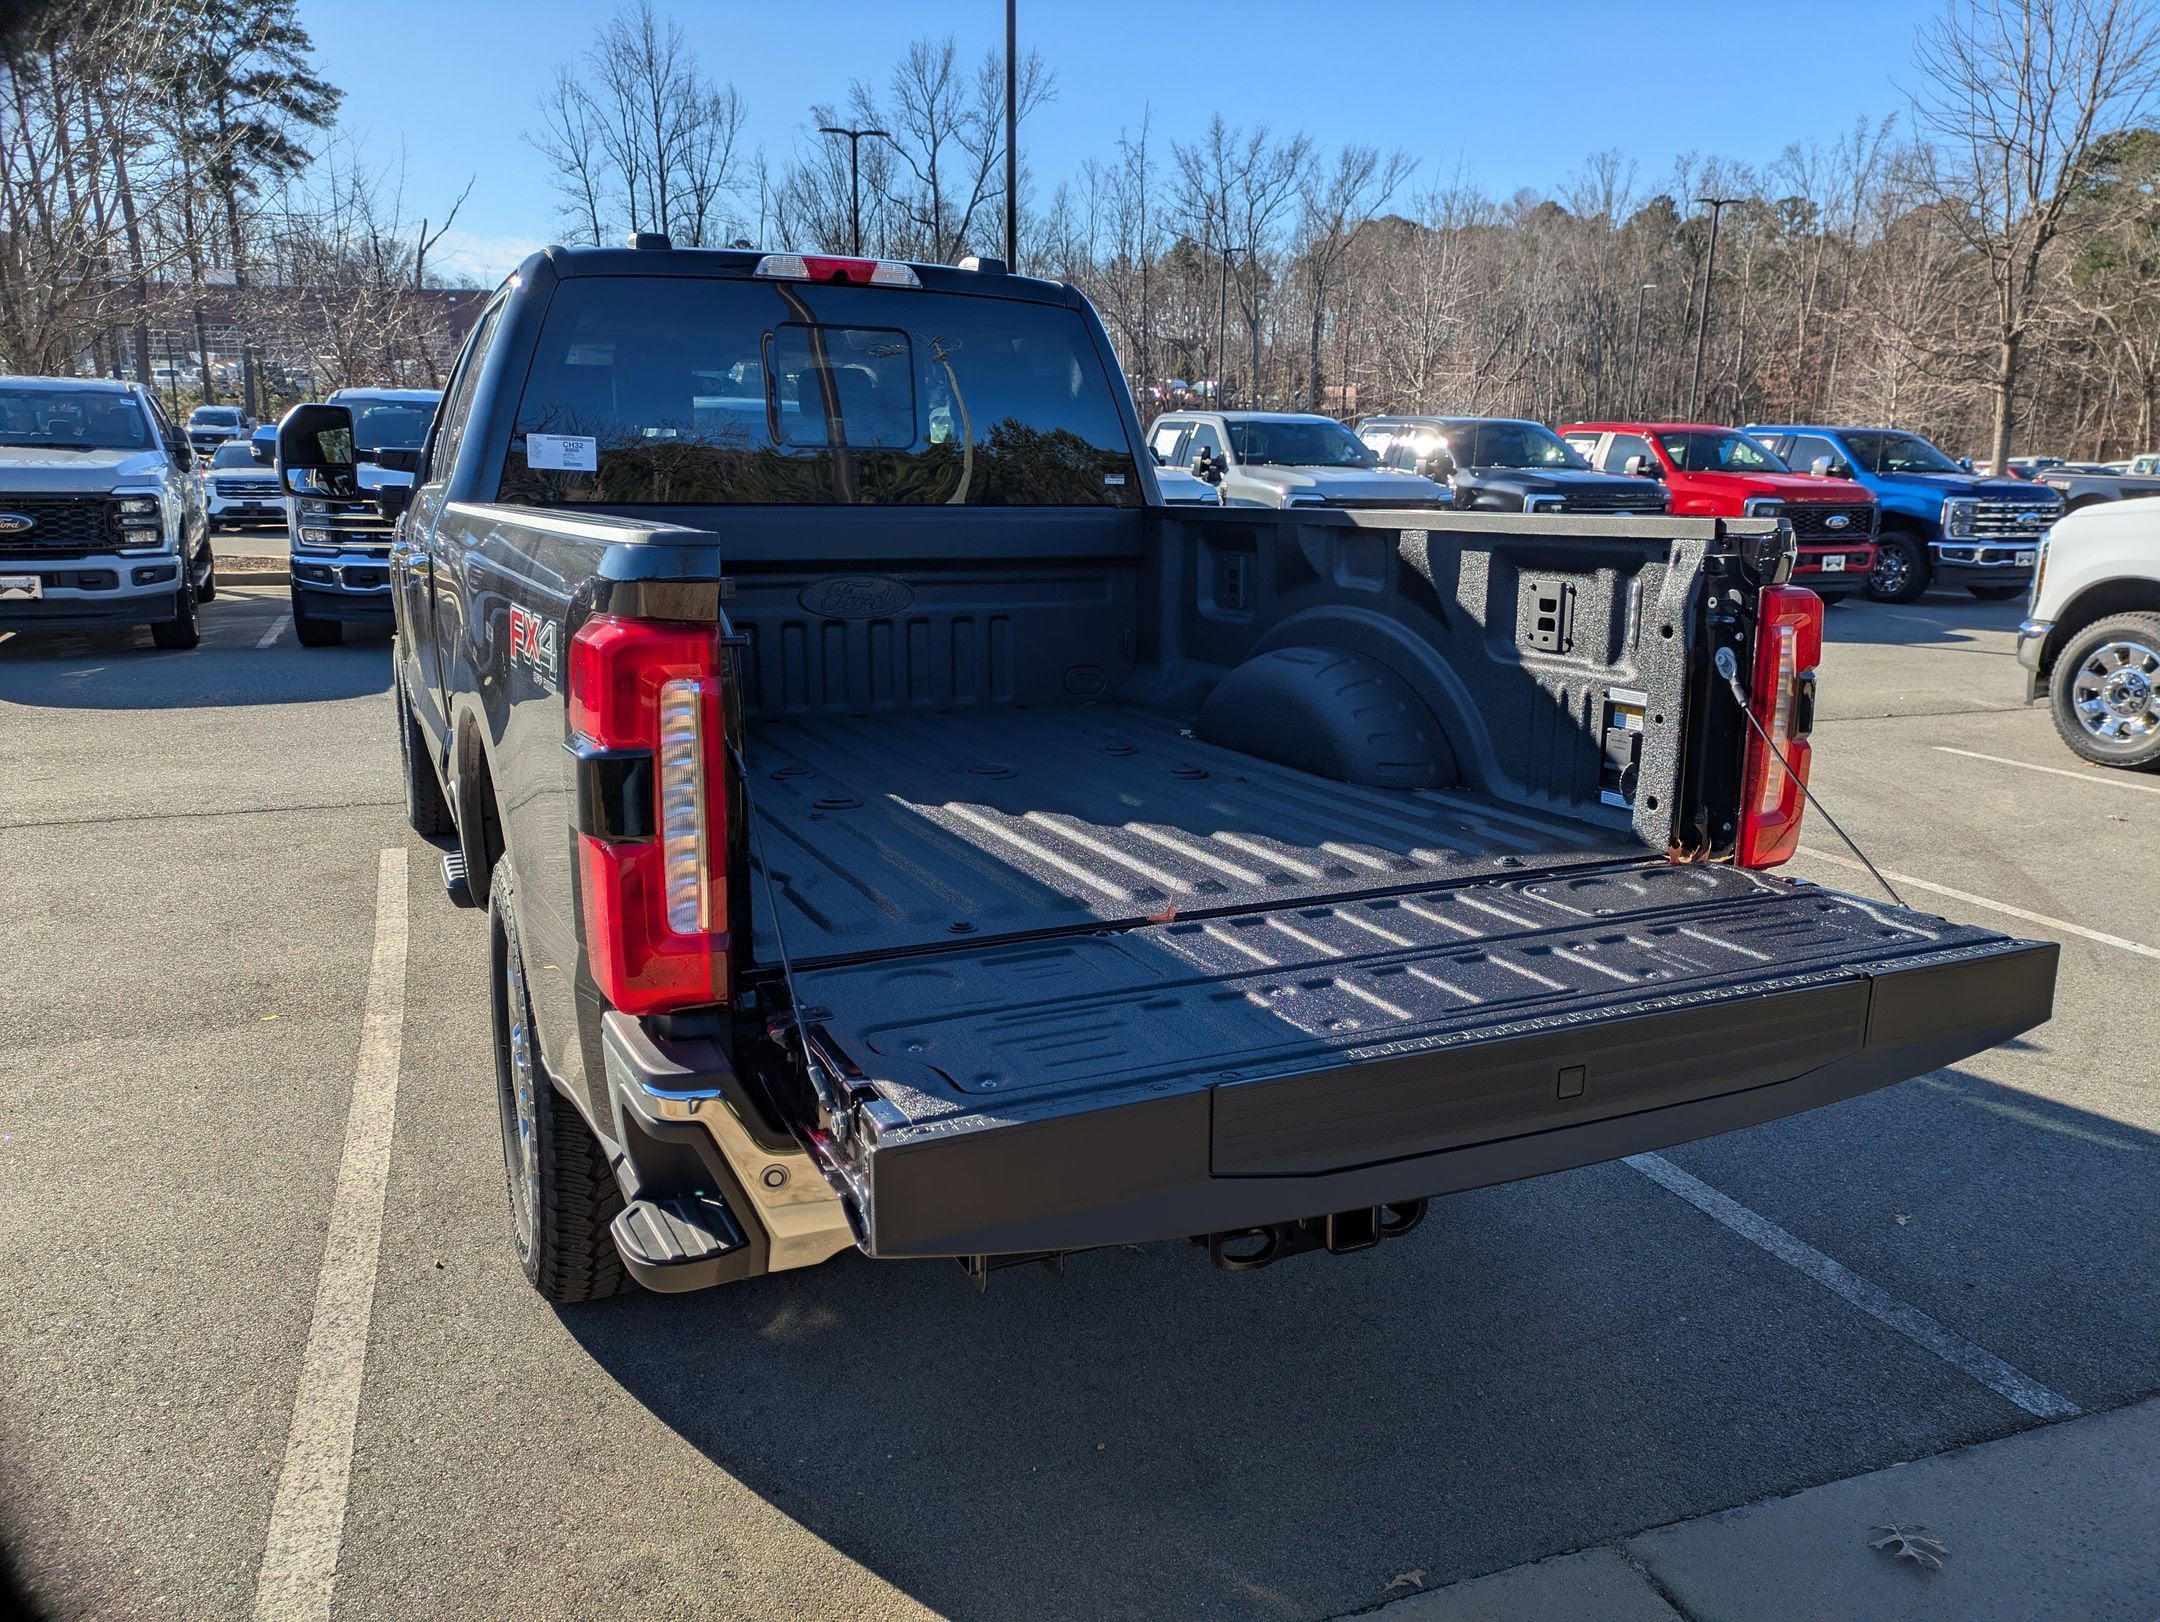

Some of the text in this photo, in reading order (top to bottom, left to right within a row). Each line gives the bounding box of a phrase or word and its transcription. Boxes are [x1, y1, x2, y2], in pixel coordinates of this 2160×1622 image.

[562, 441, 584, 449] CH32
[821, 581, 894, 611] Ford
[510, 602, 557, 682] FX4
